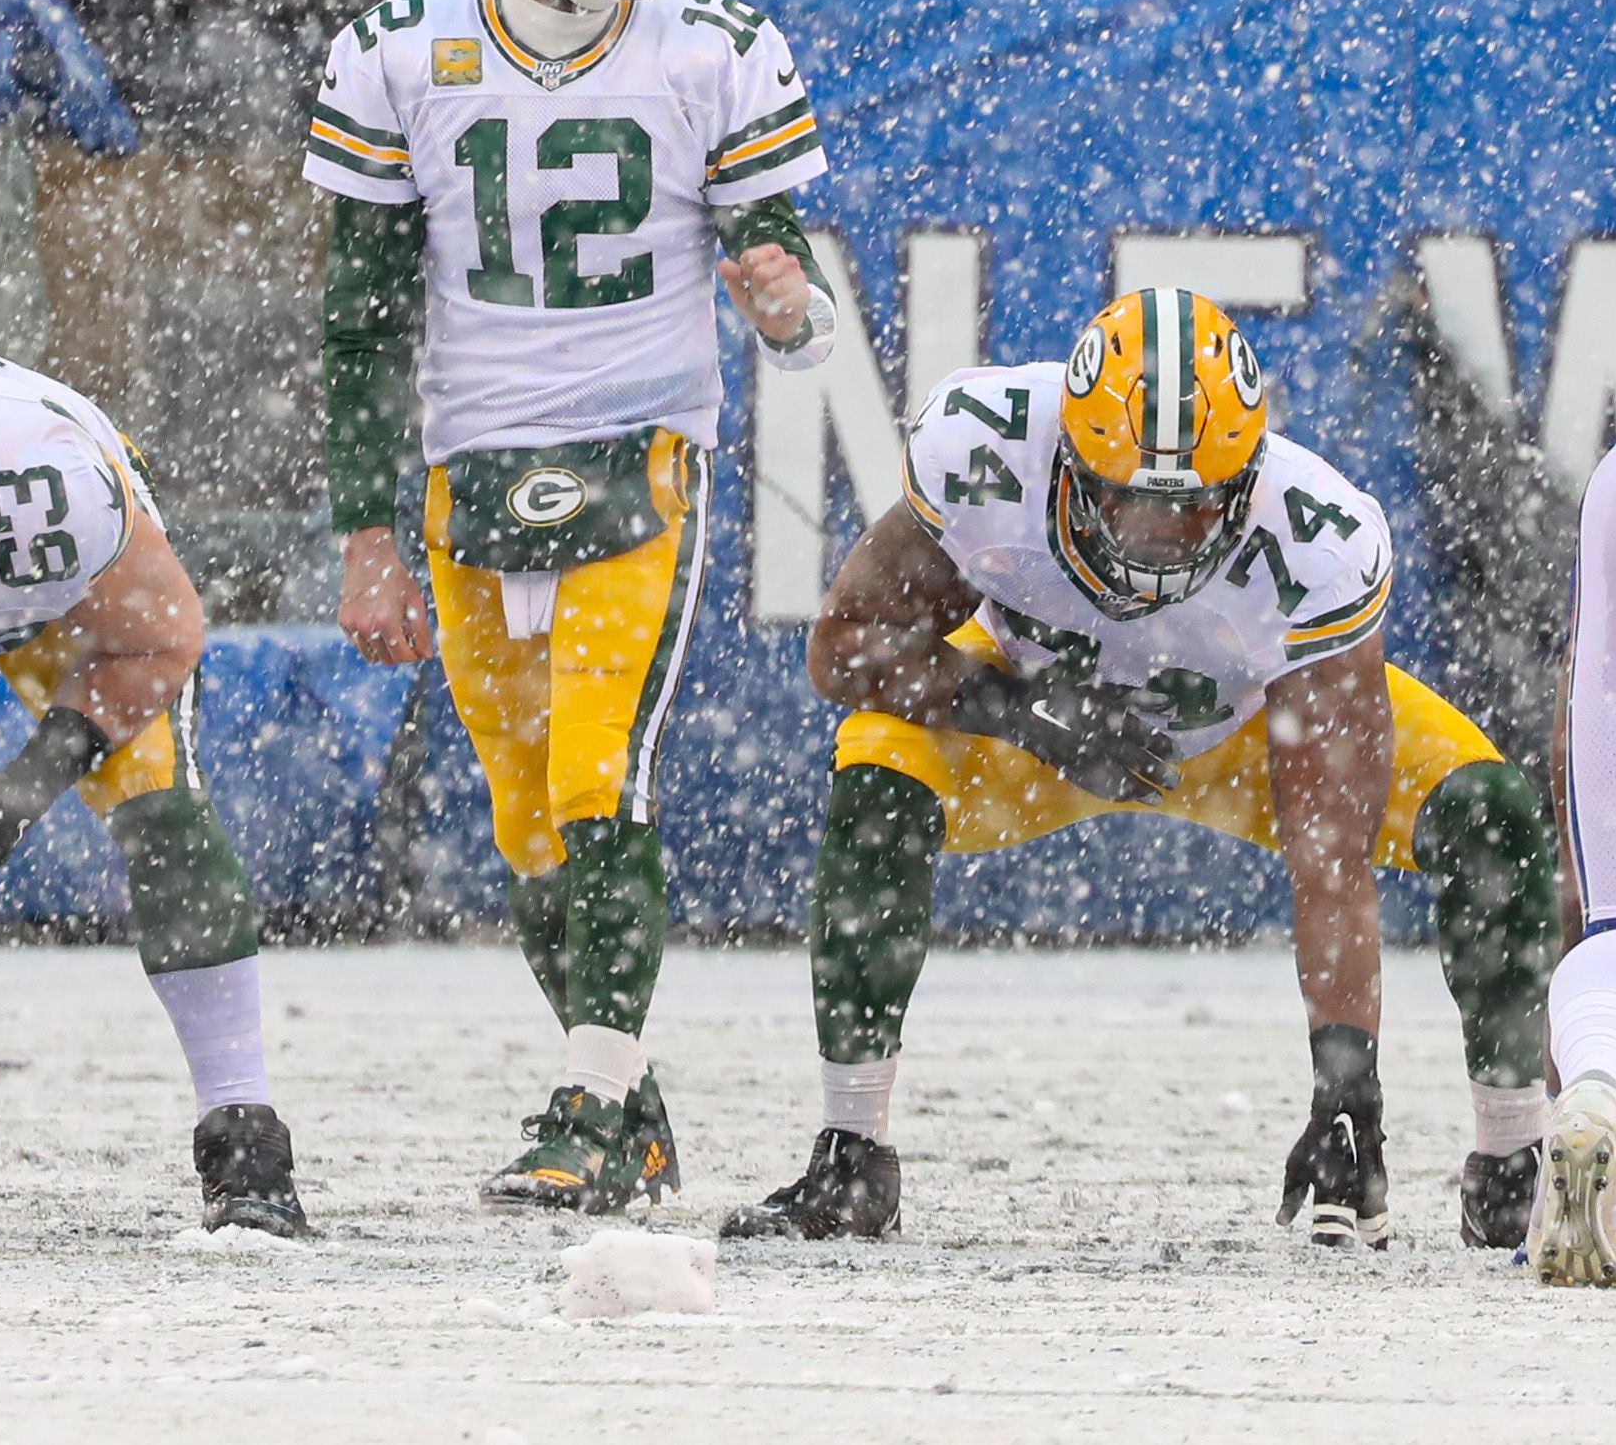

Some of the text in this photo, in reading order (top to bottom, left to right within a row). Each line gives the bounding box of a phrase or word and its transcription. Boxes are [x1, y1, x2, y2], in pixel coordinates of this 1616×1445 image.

[454, 118, 654, 309] 12
[944, 387, 1031, 507] 74
[1147, 476, 1186, 488] PACKERS
[1225, 485, 1362, 618] 74
